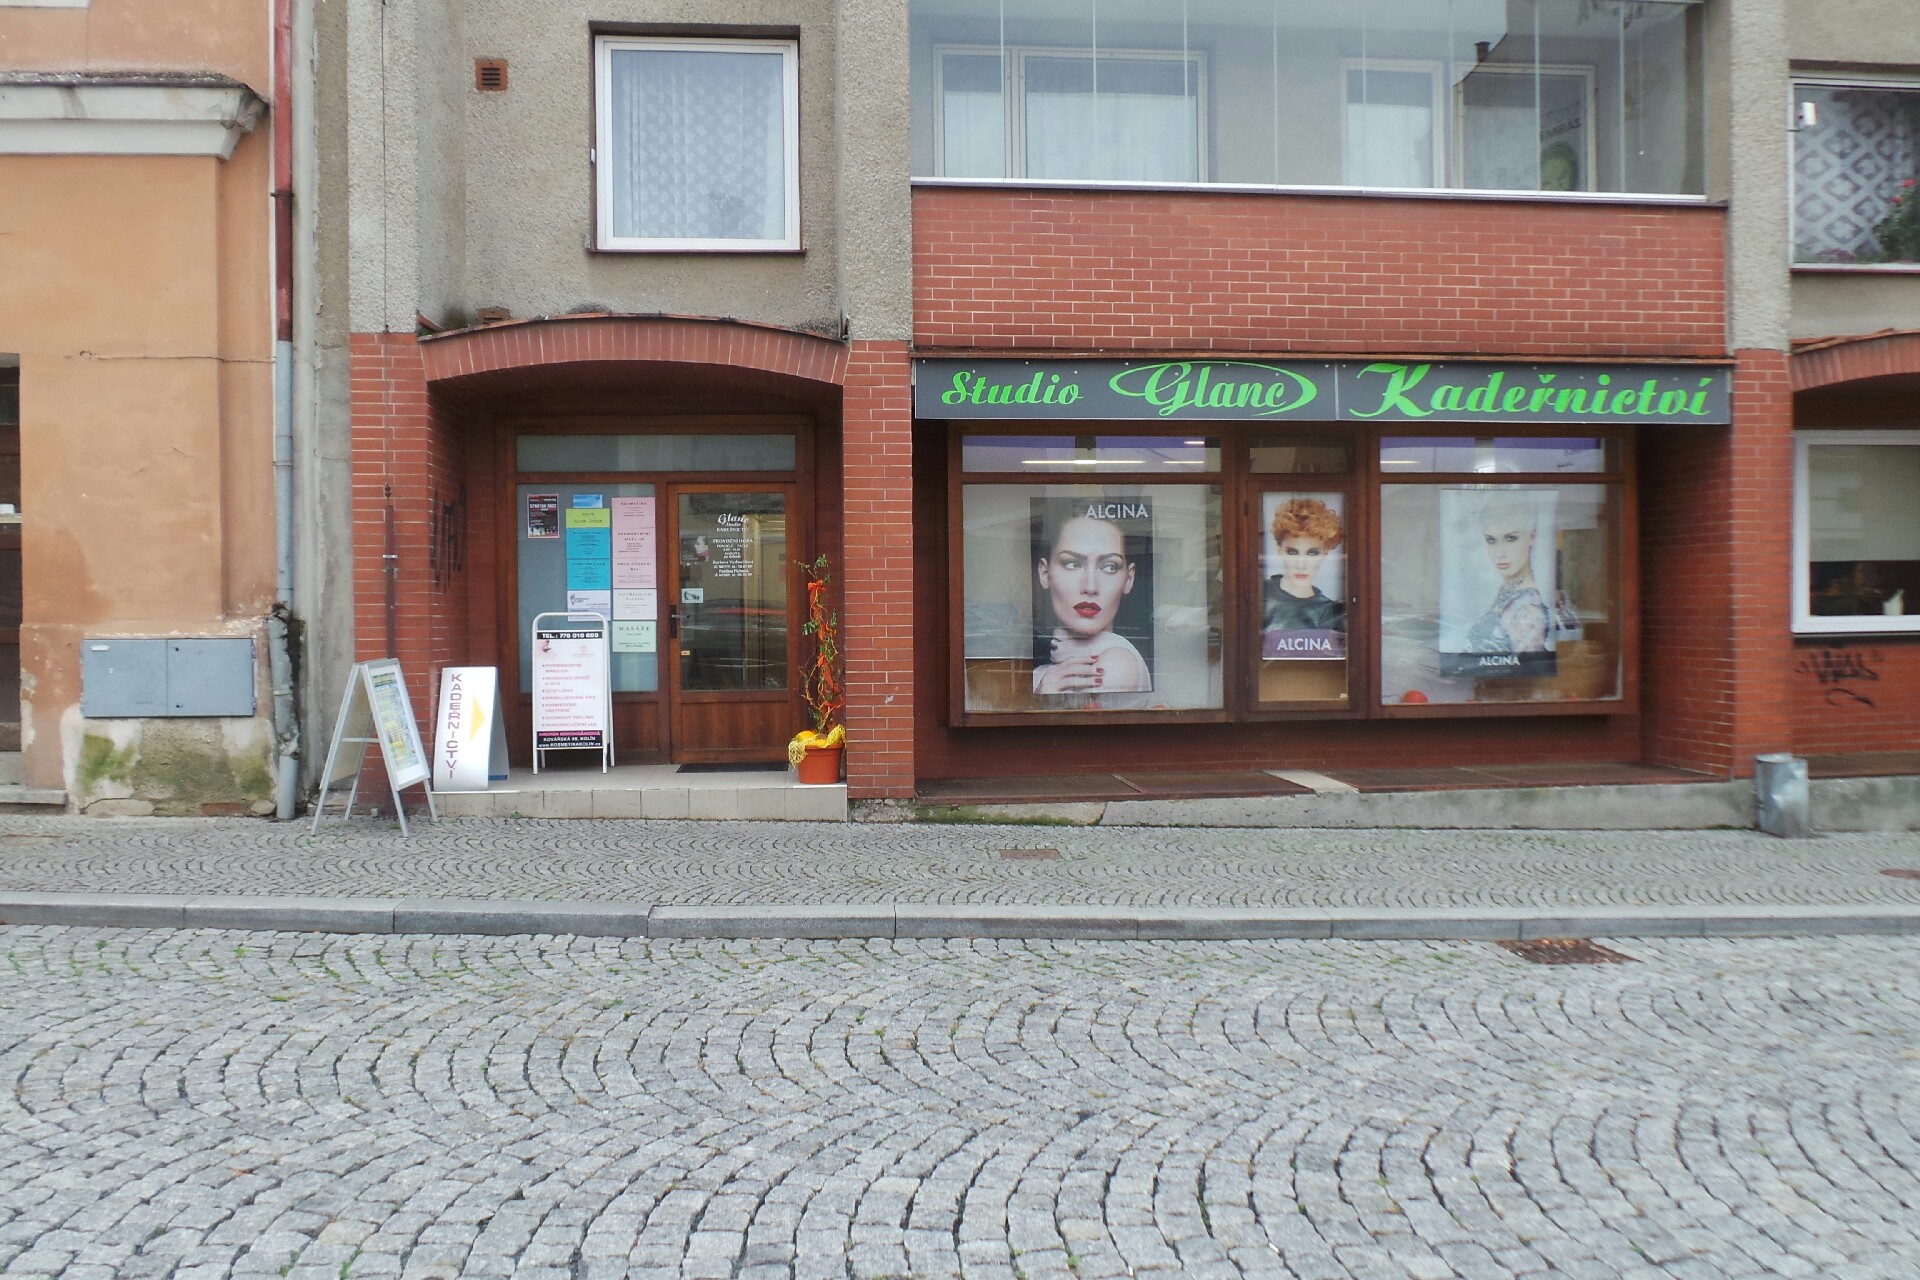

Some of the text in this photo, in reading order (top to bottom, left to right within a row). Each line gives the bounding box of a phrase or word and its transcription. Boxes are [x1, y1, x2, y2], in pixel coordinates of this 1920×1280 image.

[942, 371, 1083, 404] Studio
[1143, 361, 1288, 417] Glanc
[1350, 363, 1712, 417] Kadeřnictví
[1086, 504, 1148, 519] ALCINA
[1277, 638, 1332, 651] ALCINA
[1479, 656, 1521, 666] ALCINA
